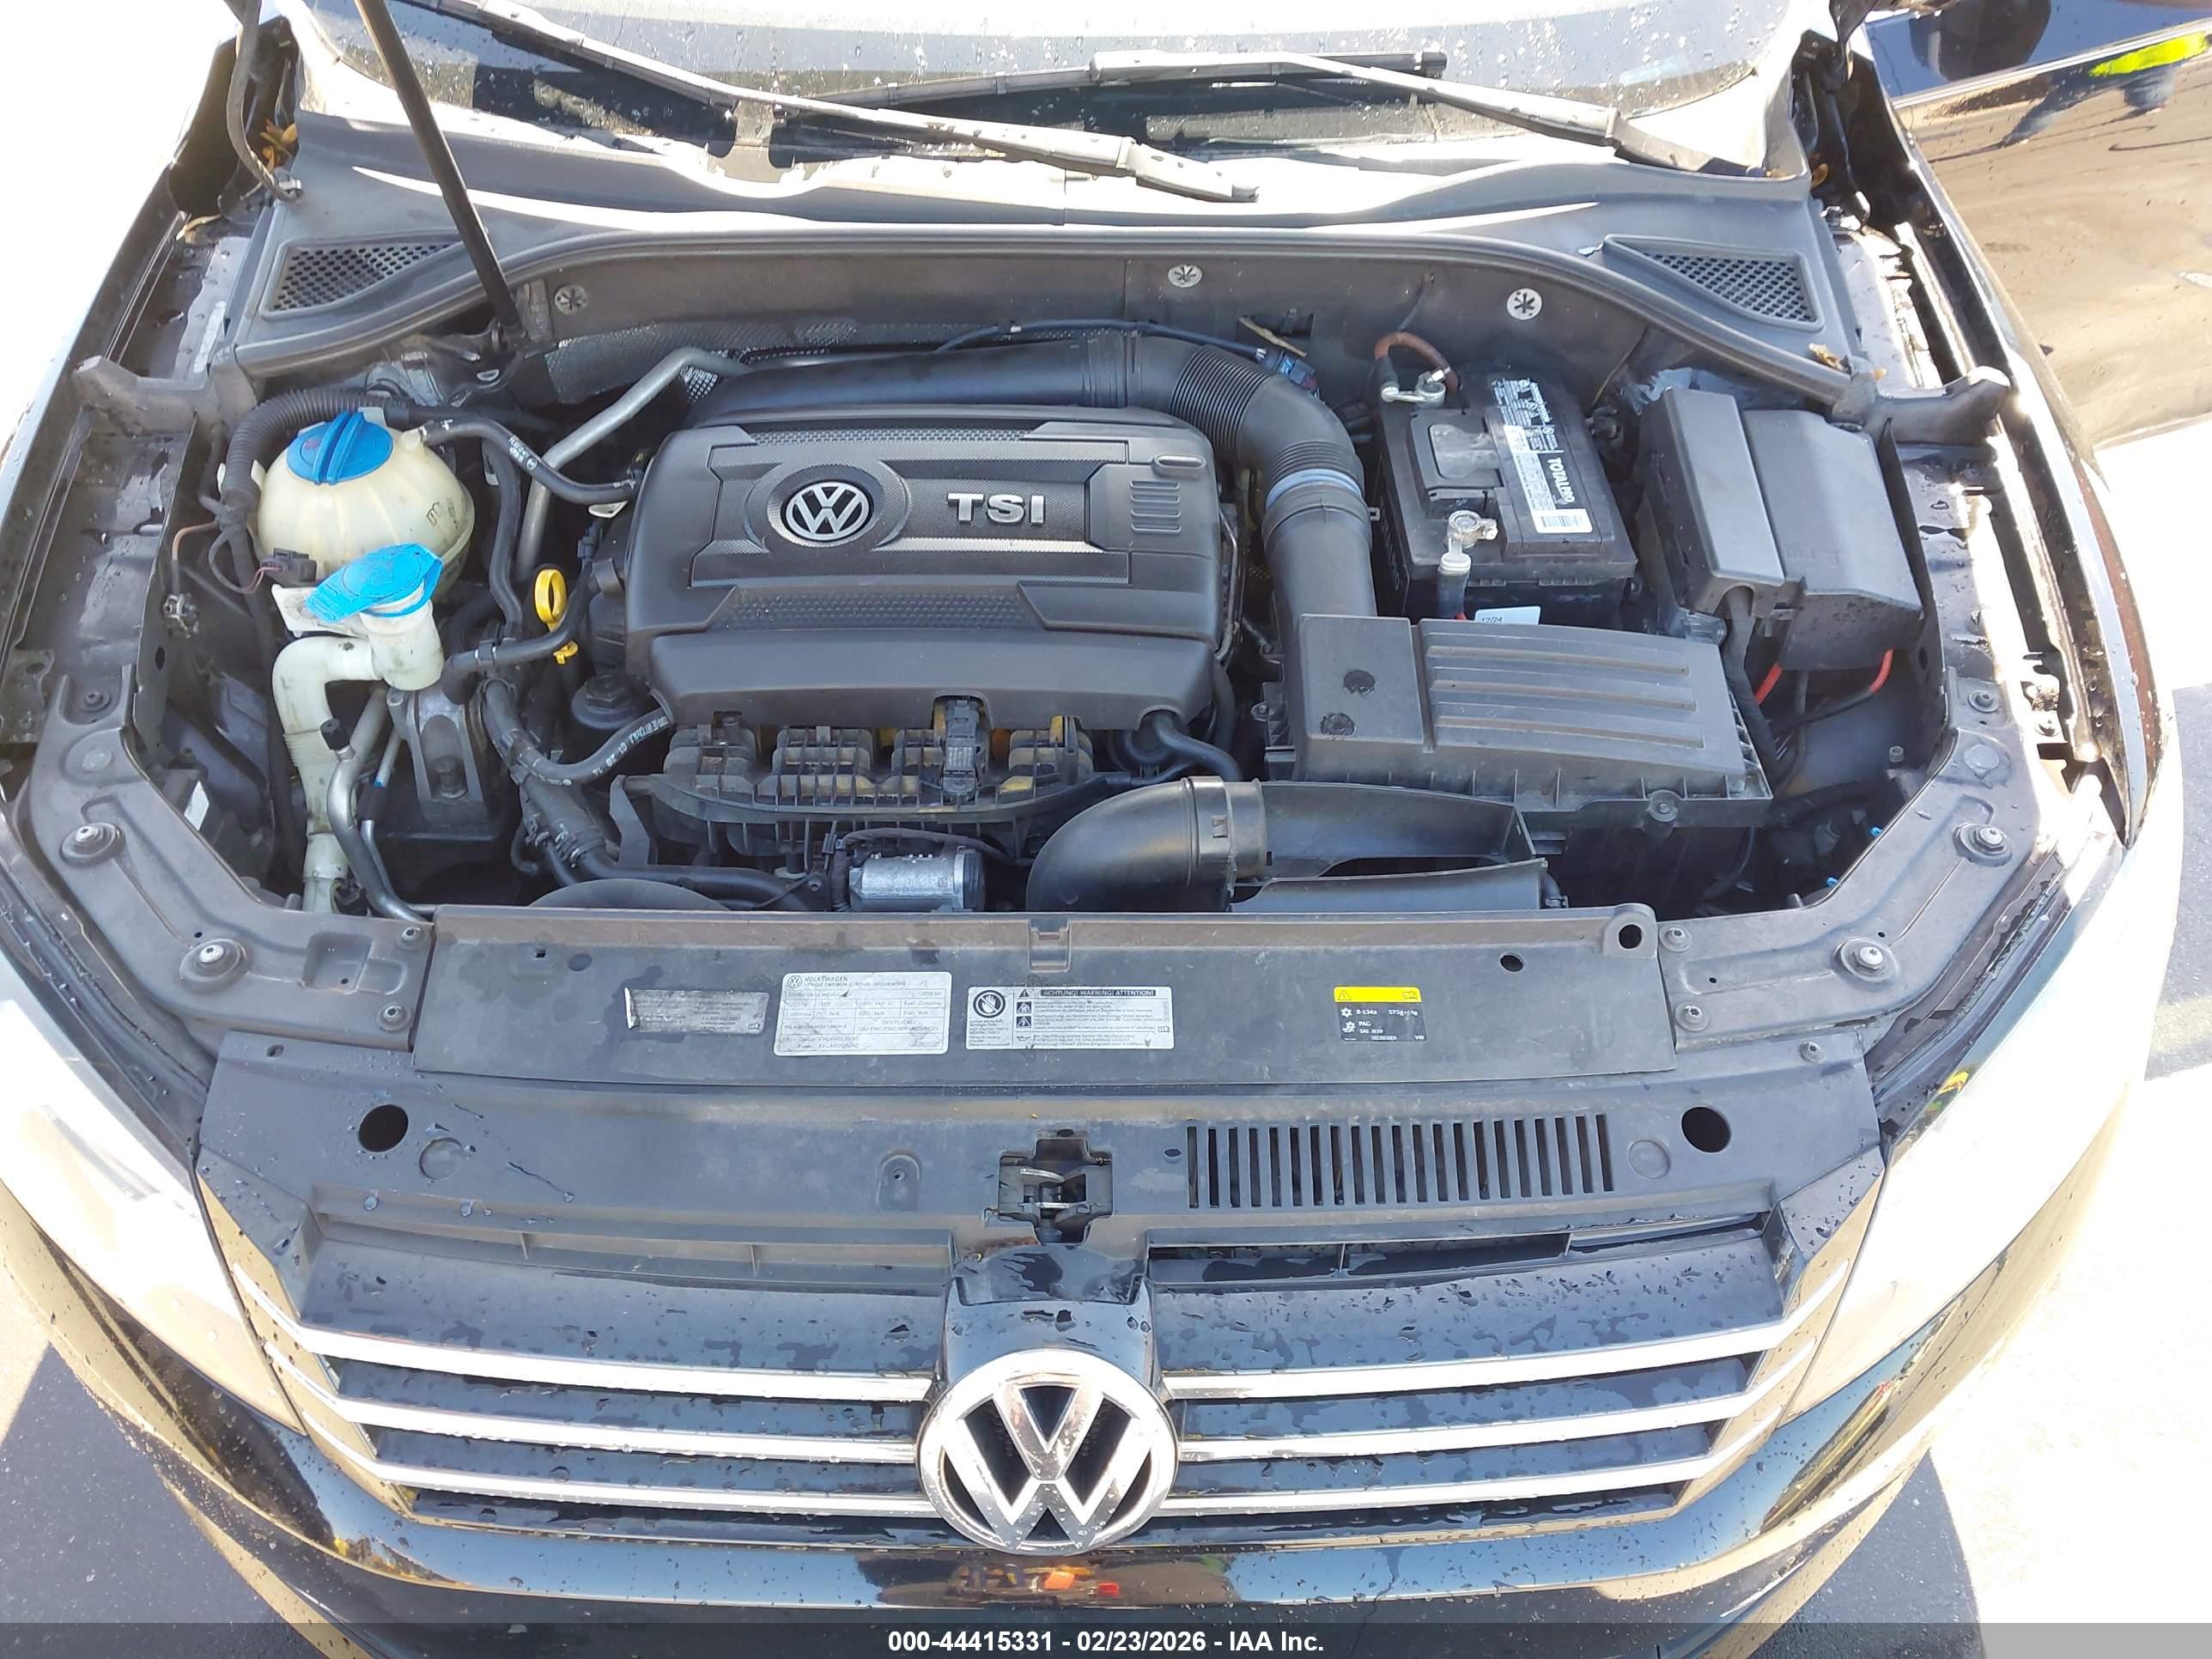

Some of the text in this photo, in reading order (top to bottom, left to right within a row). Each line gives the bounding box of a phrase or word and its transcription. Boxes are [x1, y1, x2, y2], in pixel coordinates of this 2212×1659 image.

[787, 483, 868, 540] VW
[948, 494, 1044, 524] TSI
[923, 1358, 1171, 1554] VW
